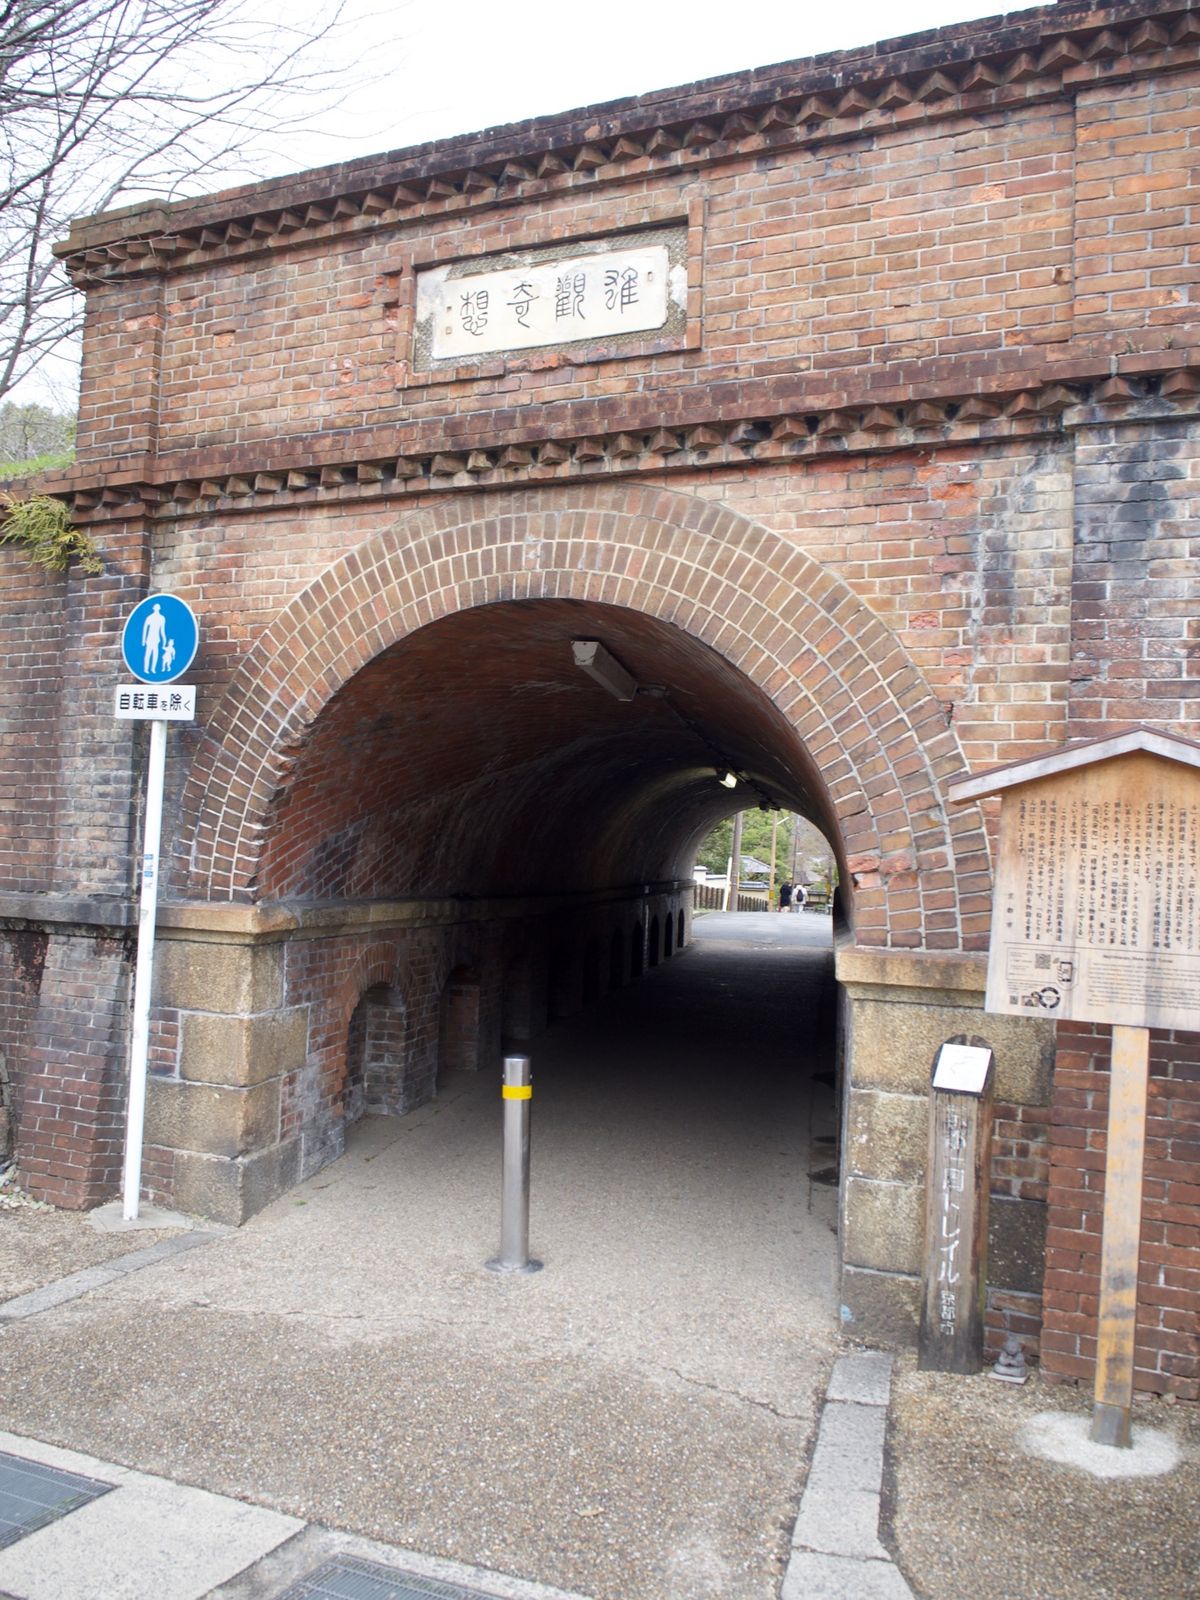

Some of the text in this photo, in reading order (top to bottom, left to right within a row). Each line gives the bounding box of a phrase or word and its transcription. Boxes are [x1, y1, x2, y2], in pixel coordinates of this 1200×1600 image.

[120, 693, 190, 711] 自転車を除く
